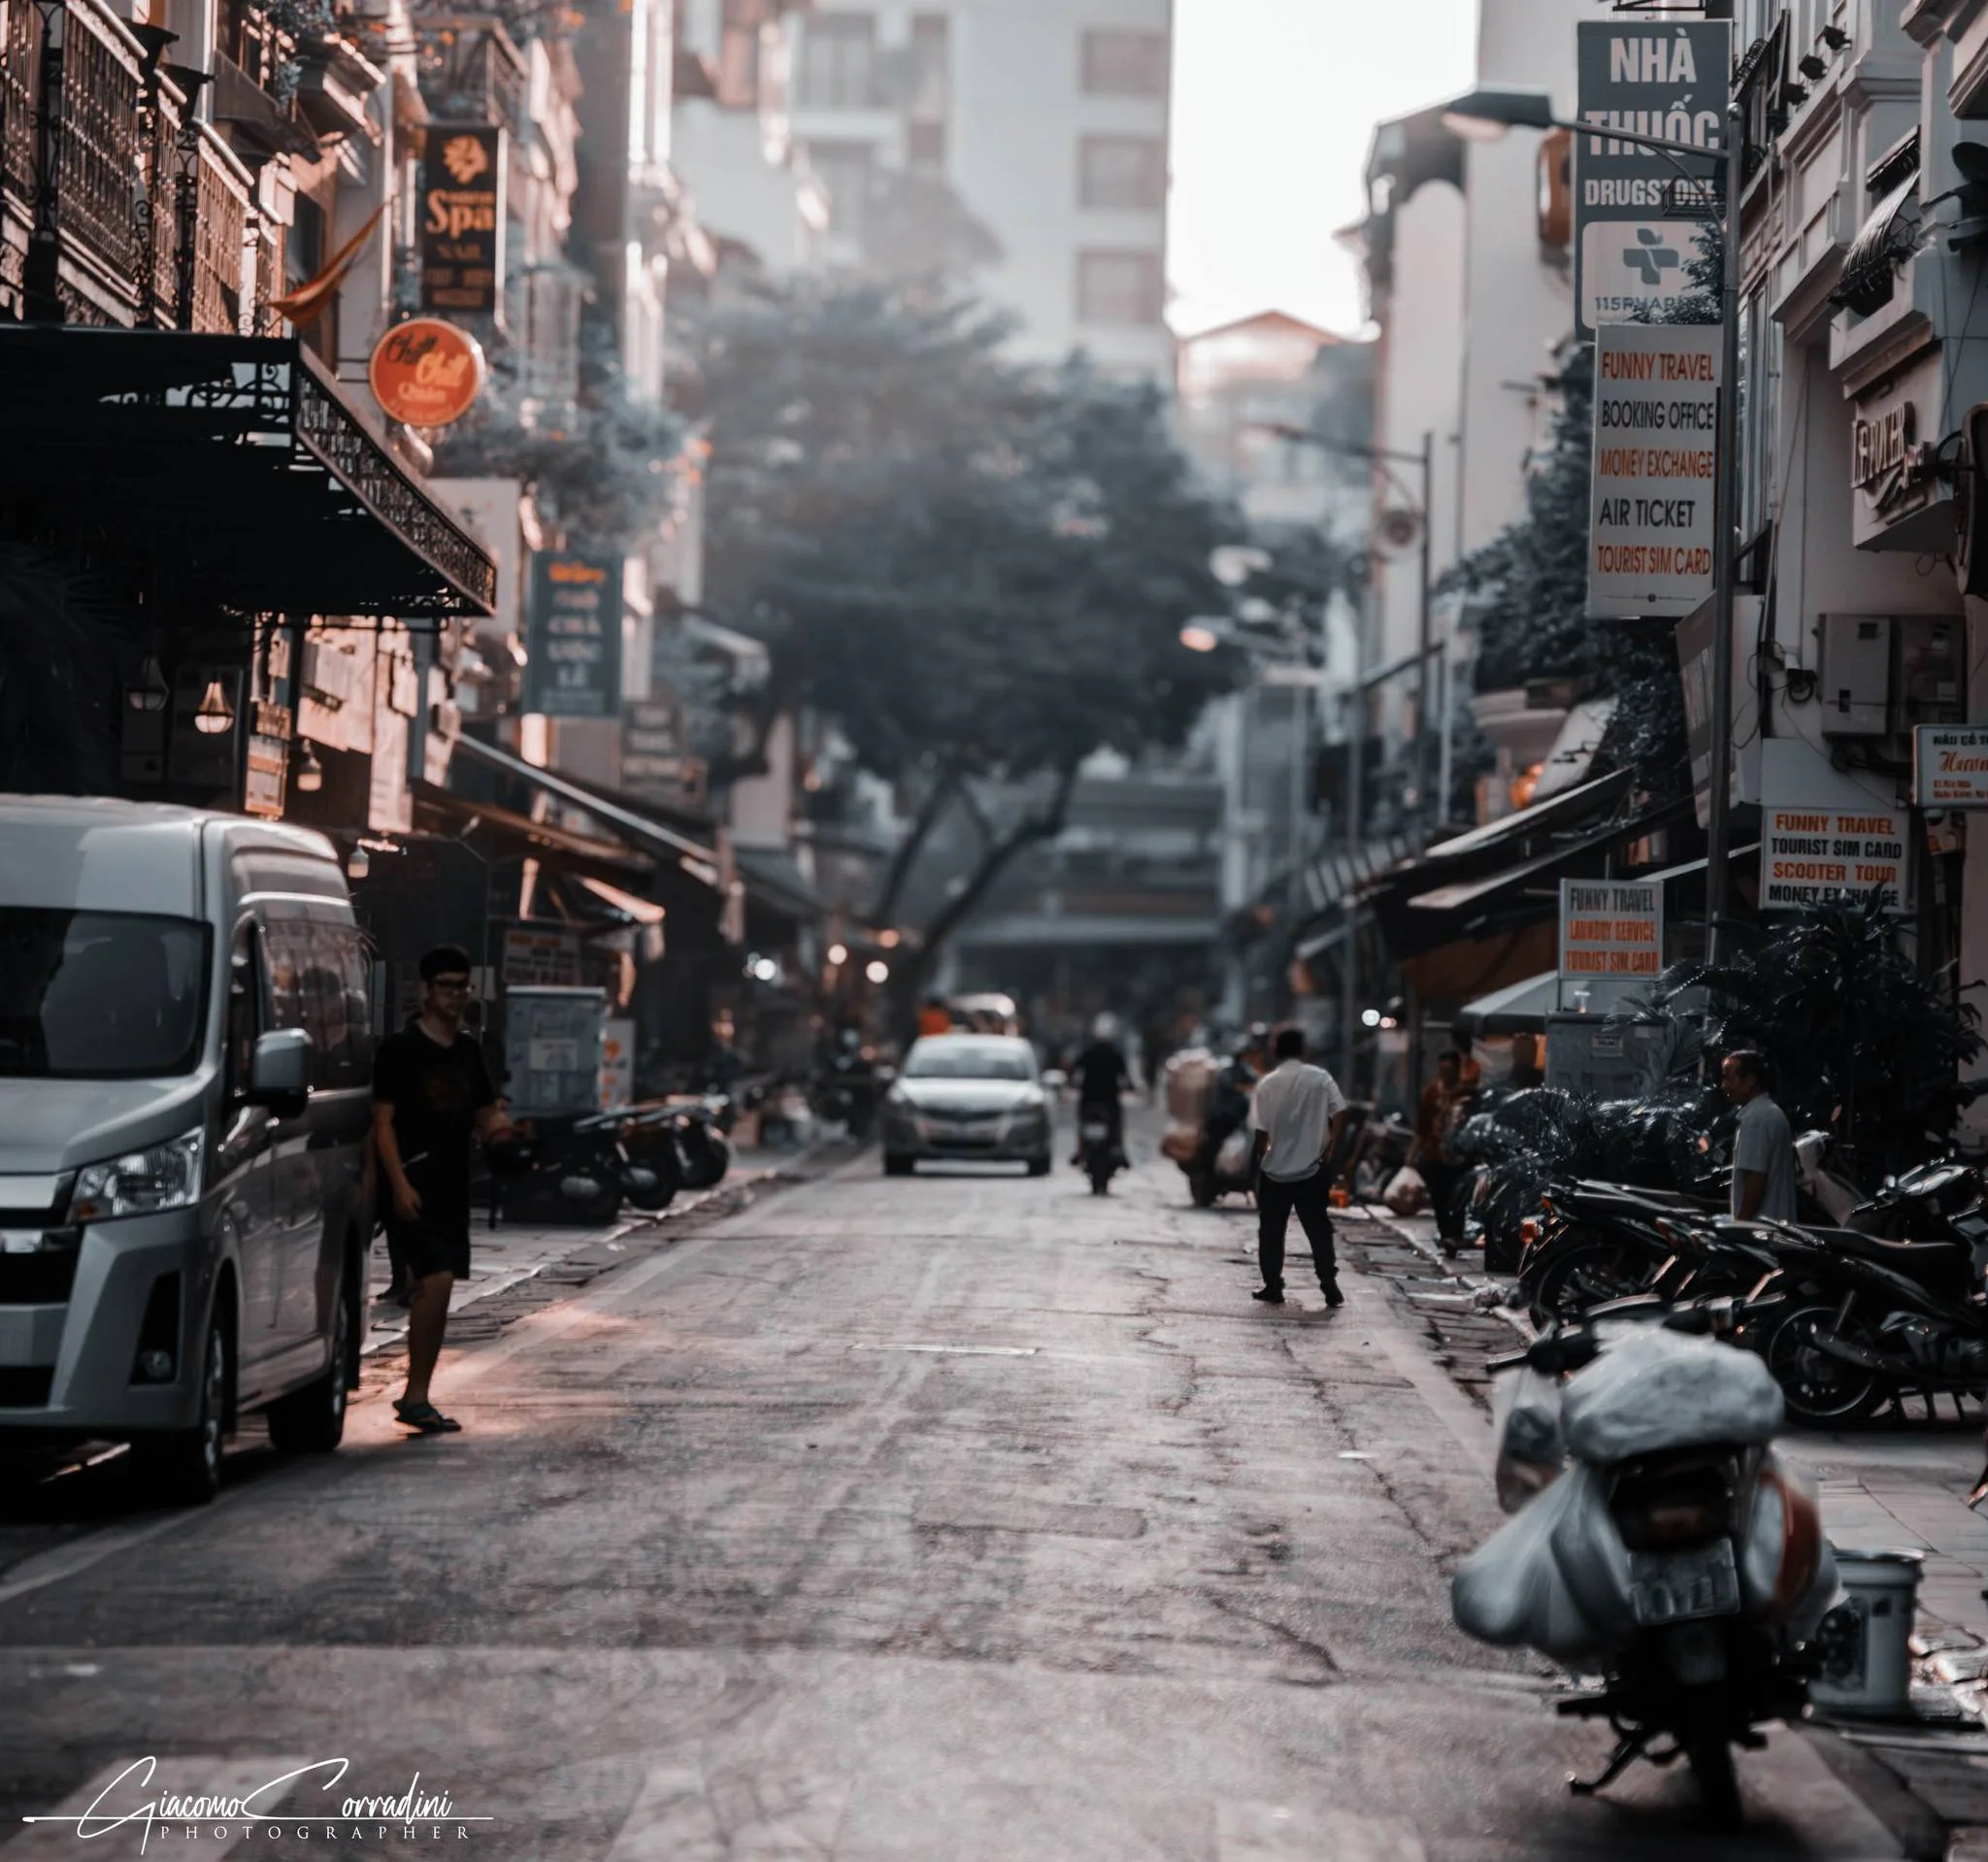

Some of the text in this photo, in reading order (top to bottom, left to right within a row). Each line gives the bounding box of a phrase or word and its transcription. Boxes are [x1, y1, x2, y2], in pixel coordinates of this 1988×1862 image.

[1610, 28, 1697, 83] NHÀ
[1584, 94, 1719, 155] THUỐC
[425, 189, 494, 239] Spa
[1602, 351, 1714, 382] FUNNY TRAVEL
[1602, 400, 1713, 430] BOOKING OFFICE
[1601, 449, 1713, 478] MONEY EXCHANGE
[1600, 498, 1696, 527] AIR TICKET
[1598, 546, 1711, 575] TOURIST SIM CARD
[1775, 814, 1895, 835] FUNNY TRAVEL
[1772, 837, 1903, 859] TOURIST SIM CARD
[1773, 861, 1897, 882] SCOOTER TOUR
[1571, 887, 1654, 912] FUNNY TRAVEL
[1769, 884, 1819, 903] MONEY
